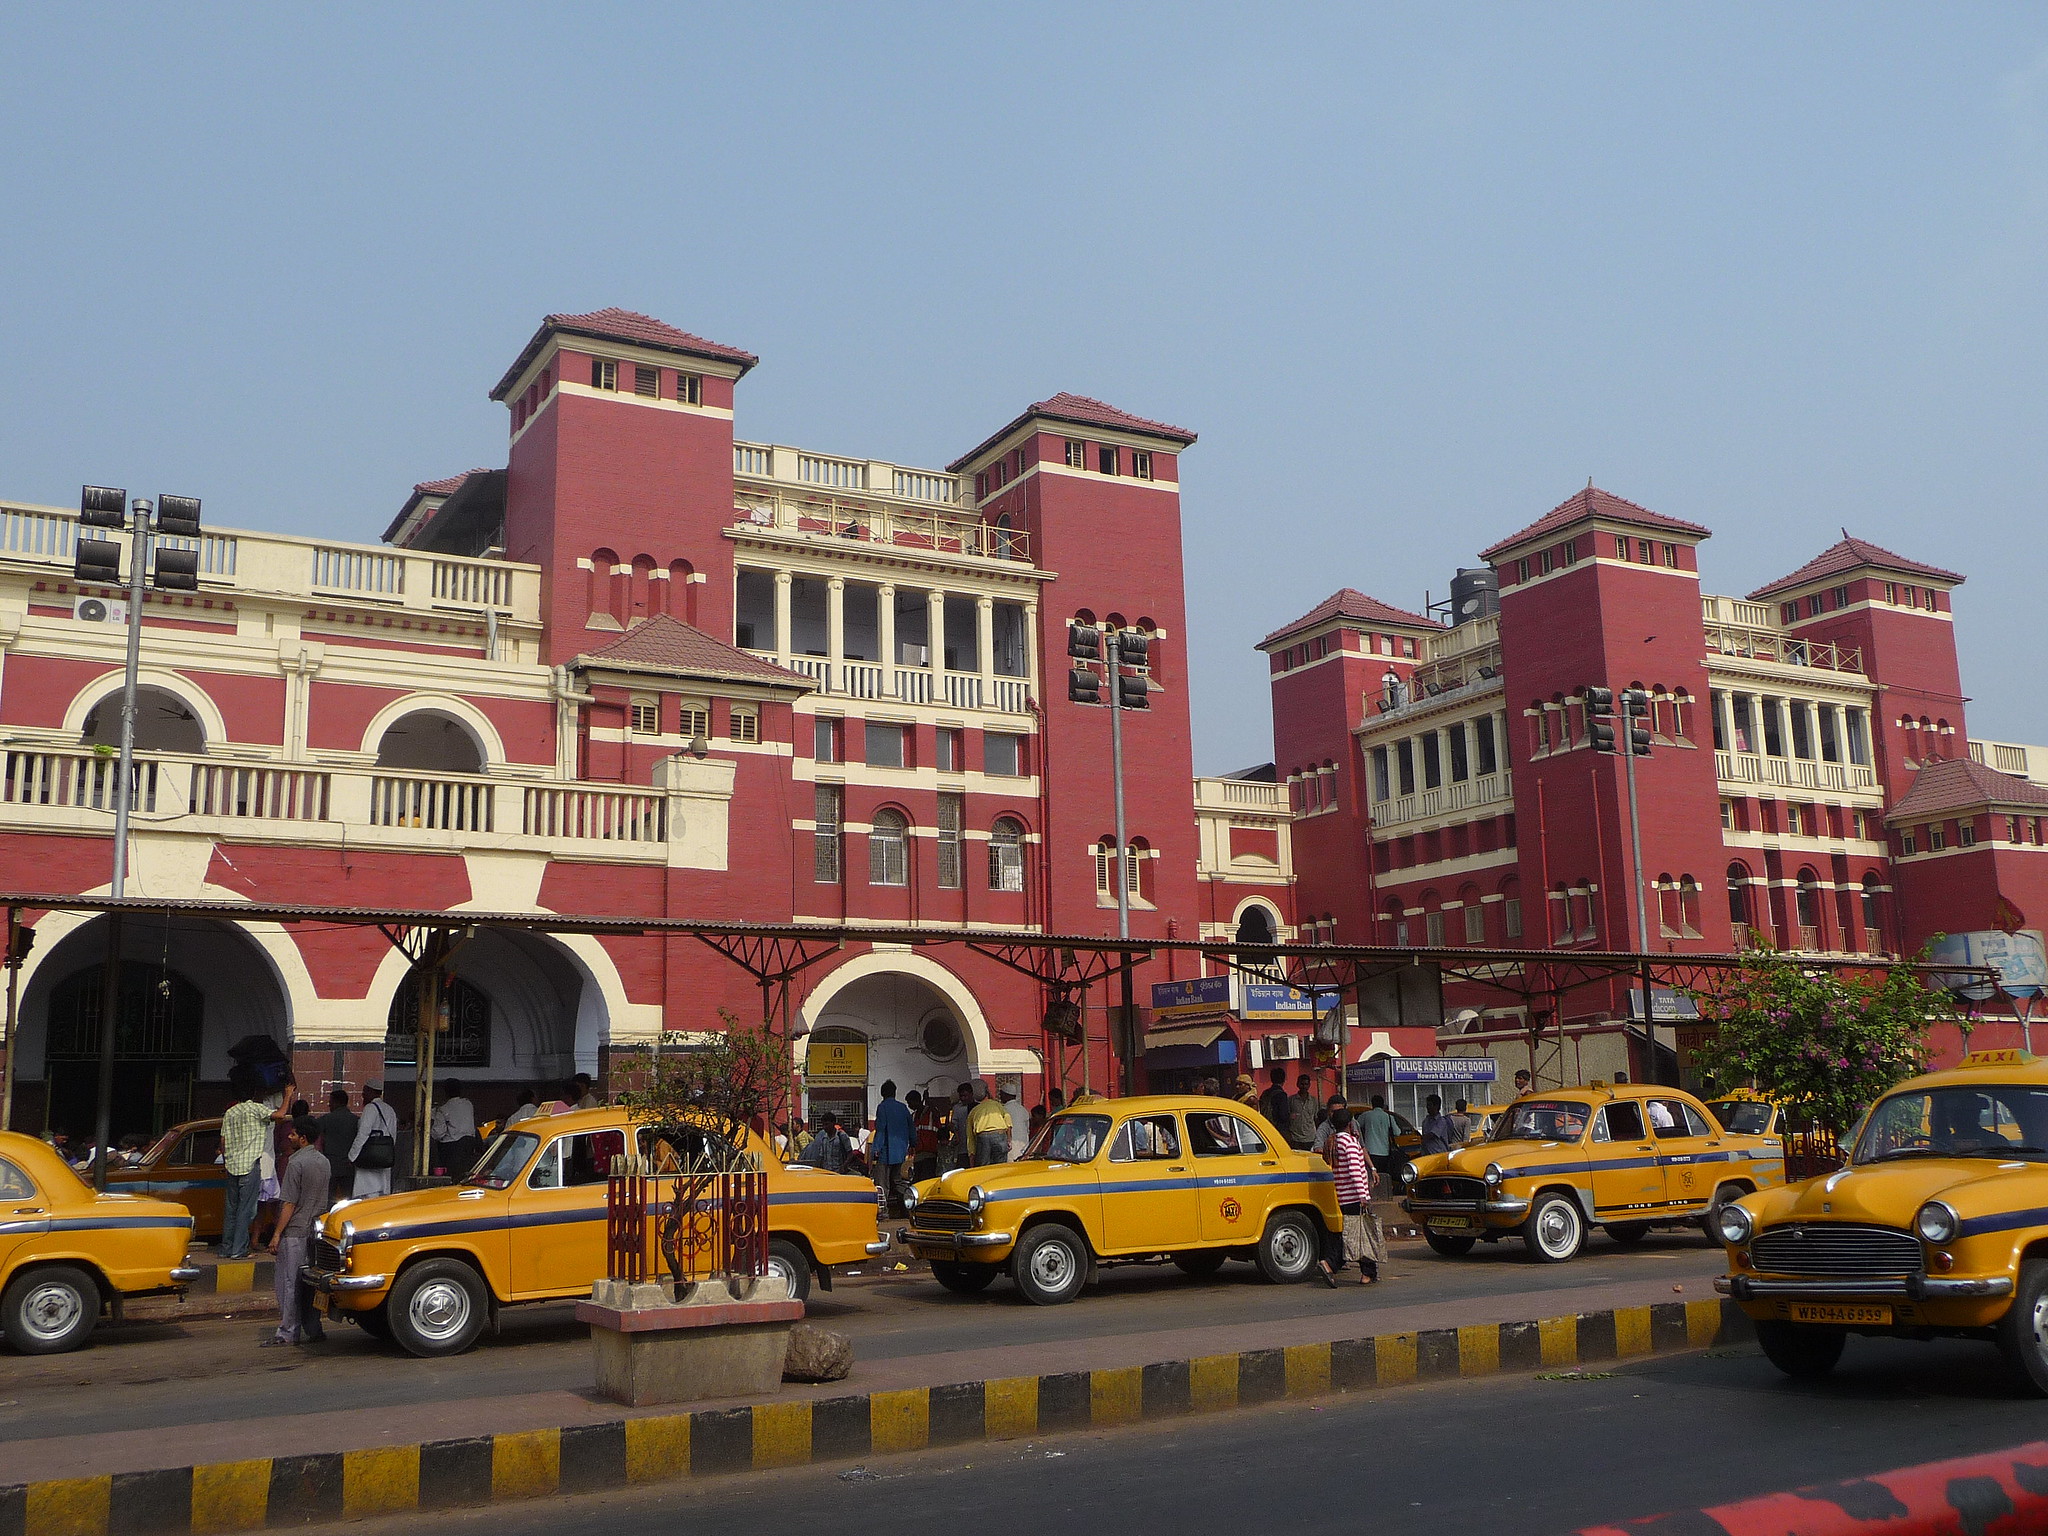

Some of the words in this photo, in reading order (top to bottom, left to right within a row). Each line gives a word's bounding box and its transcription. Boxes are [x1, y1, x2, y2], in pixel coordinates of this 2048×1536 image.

[1175, 996, 1191, 1005] Indian
[1191, 994, 1204, 1003] Bank
[1275, 1001, 1296, 1010] Indian
[1970, 1051, 2015, 1063] TAXI
[1395, 1060, 1423, 1071] POLICE
[1424, 1060, 1468, 1071] ASSISTANCE
[1468, 1060, 1493, 1072] BOOTH
